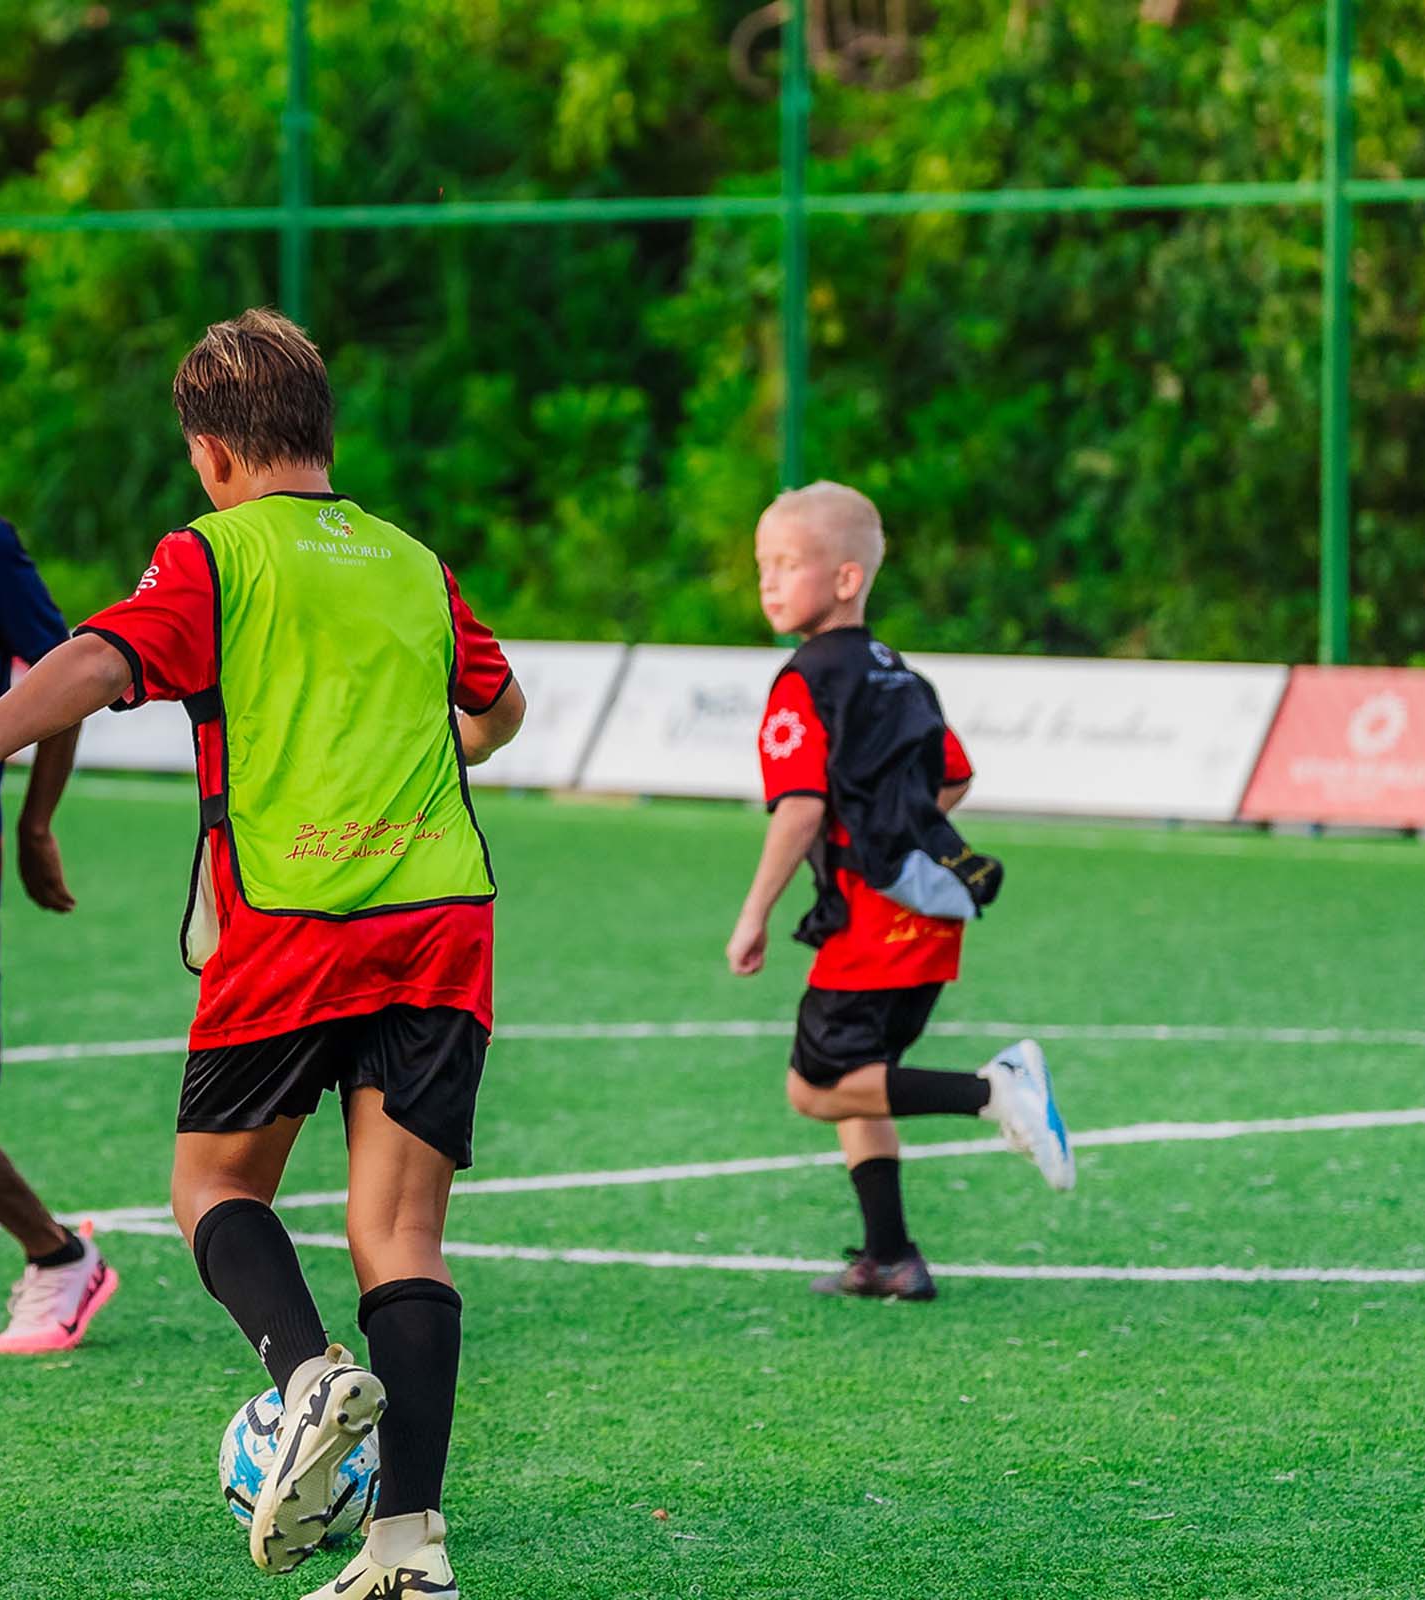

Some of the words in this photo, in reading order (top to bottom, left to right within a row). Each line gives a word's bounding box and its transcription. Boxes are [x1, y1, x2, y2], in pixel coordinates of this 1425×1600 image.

[296, 539, 337, 555] SIYAM
[339, 543, 392, 560] WORLD
[286, 841, 332, 861] Hello
